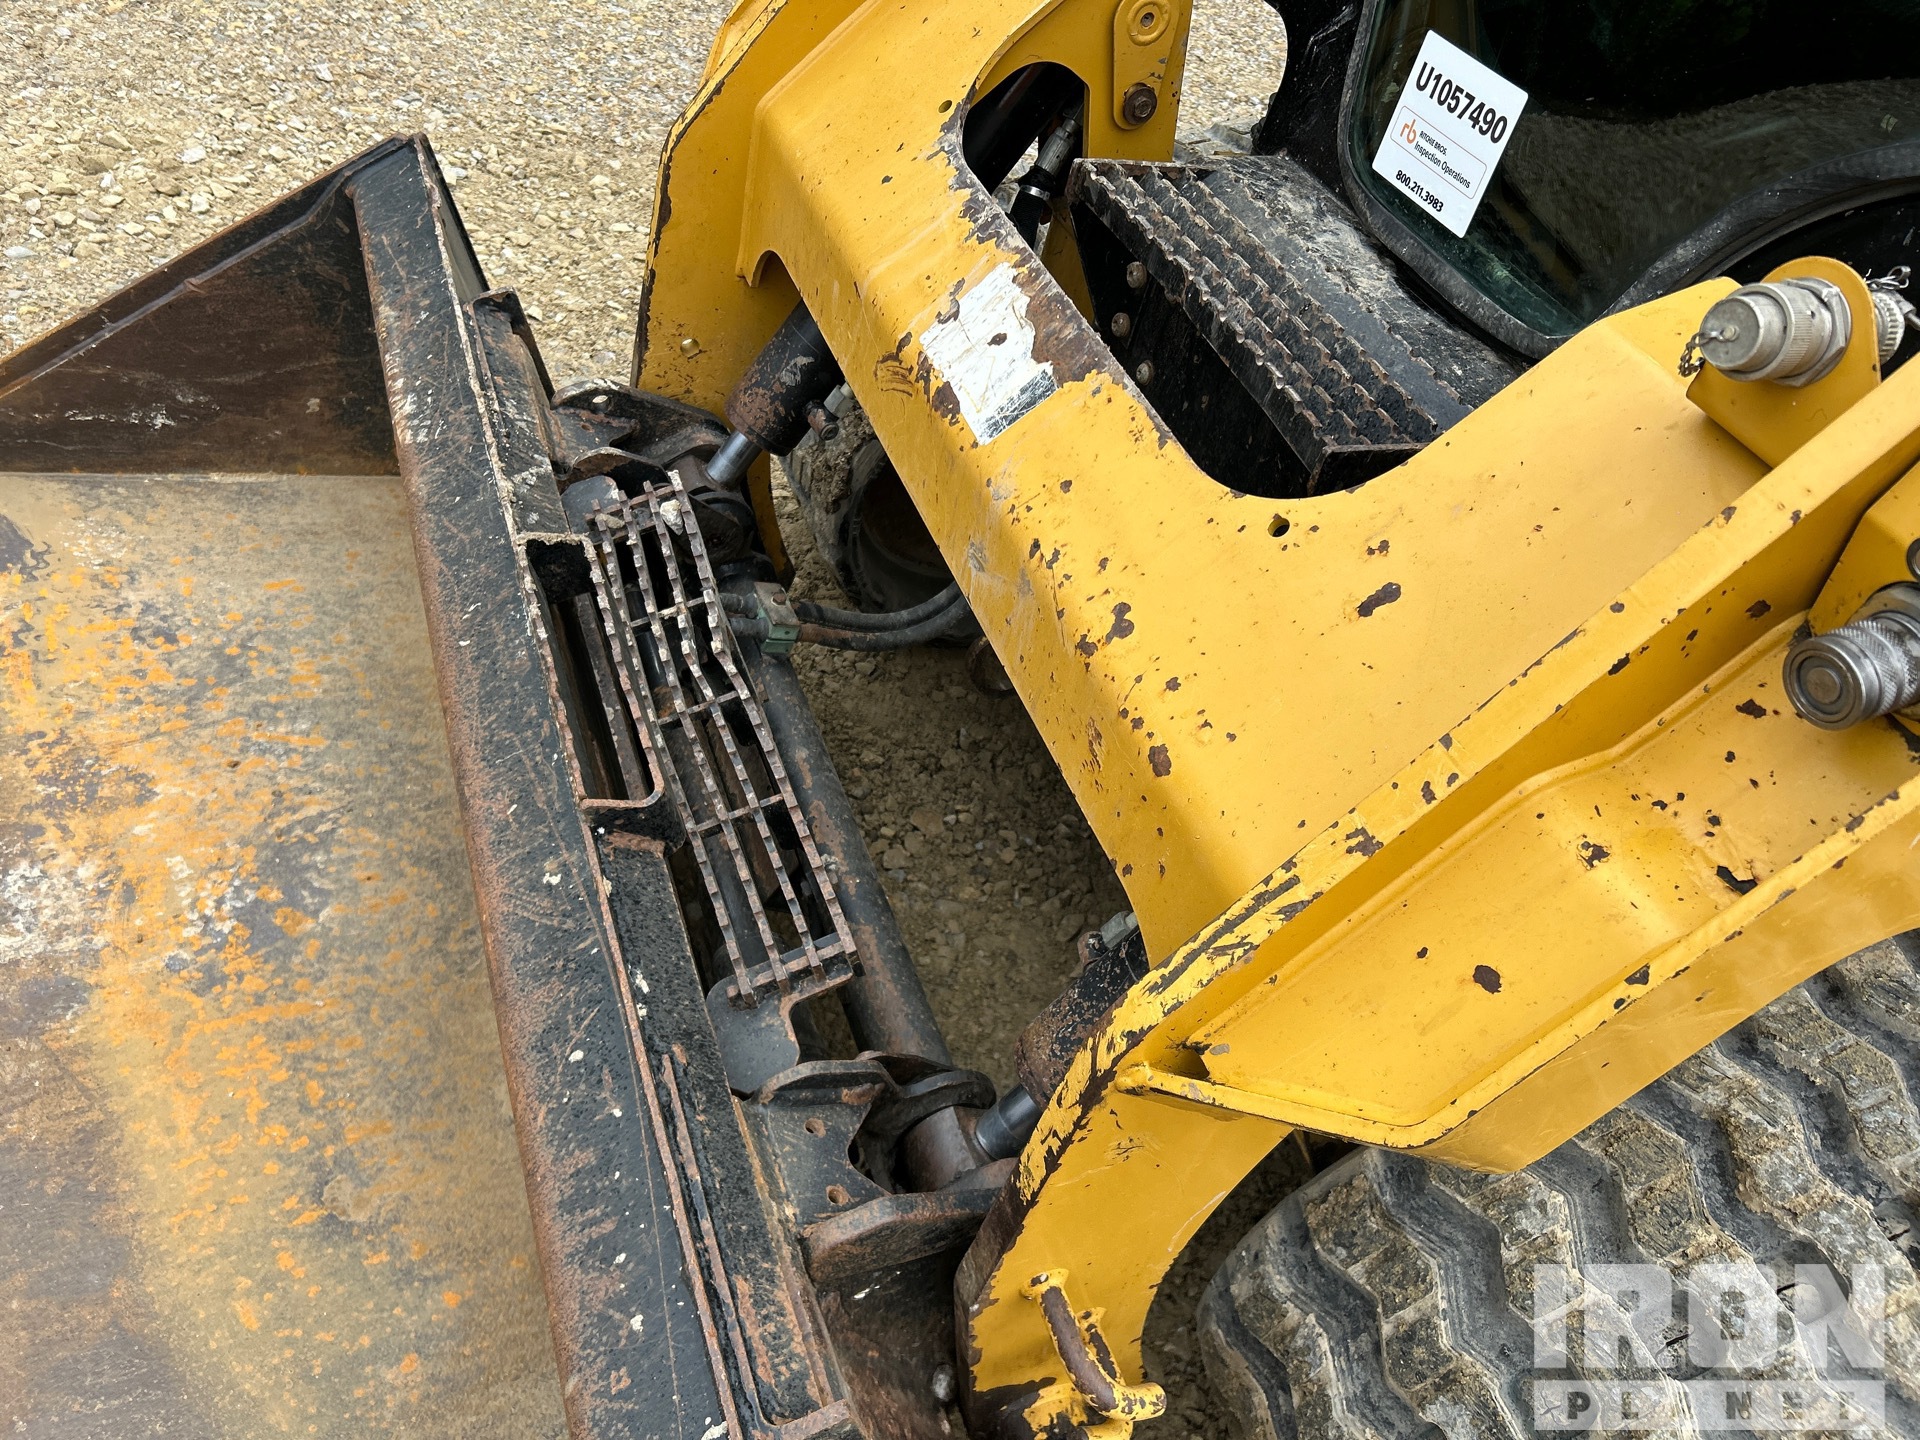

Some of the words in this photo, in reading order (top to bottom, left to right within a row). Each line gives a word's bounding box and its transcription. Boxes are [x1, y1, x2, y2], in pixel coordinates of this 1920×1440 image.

[1415, 61, 1508, 144] U1057490
[1413, 141, 1442, 167] Inspection
[1441, 161, 1471, 189] Operations
[1419, 130, 1435, 147] RITCHIE
[1433, 141, 1447, 156] BROS.
[1395, 169, 1444, 213] 800.211.3983
